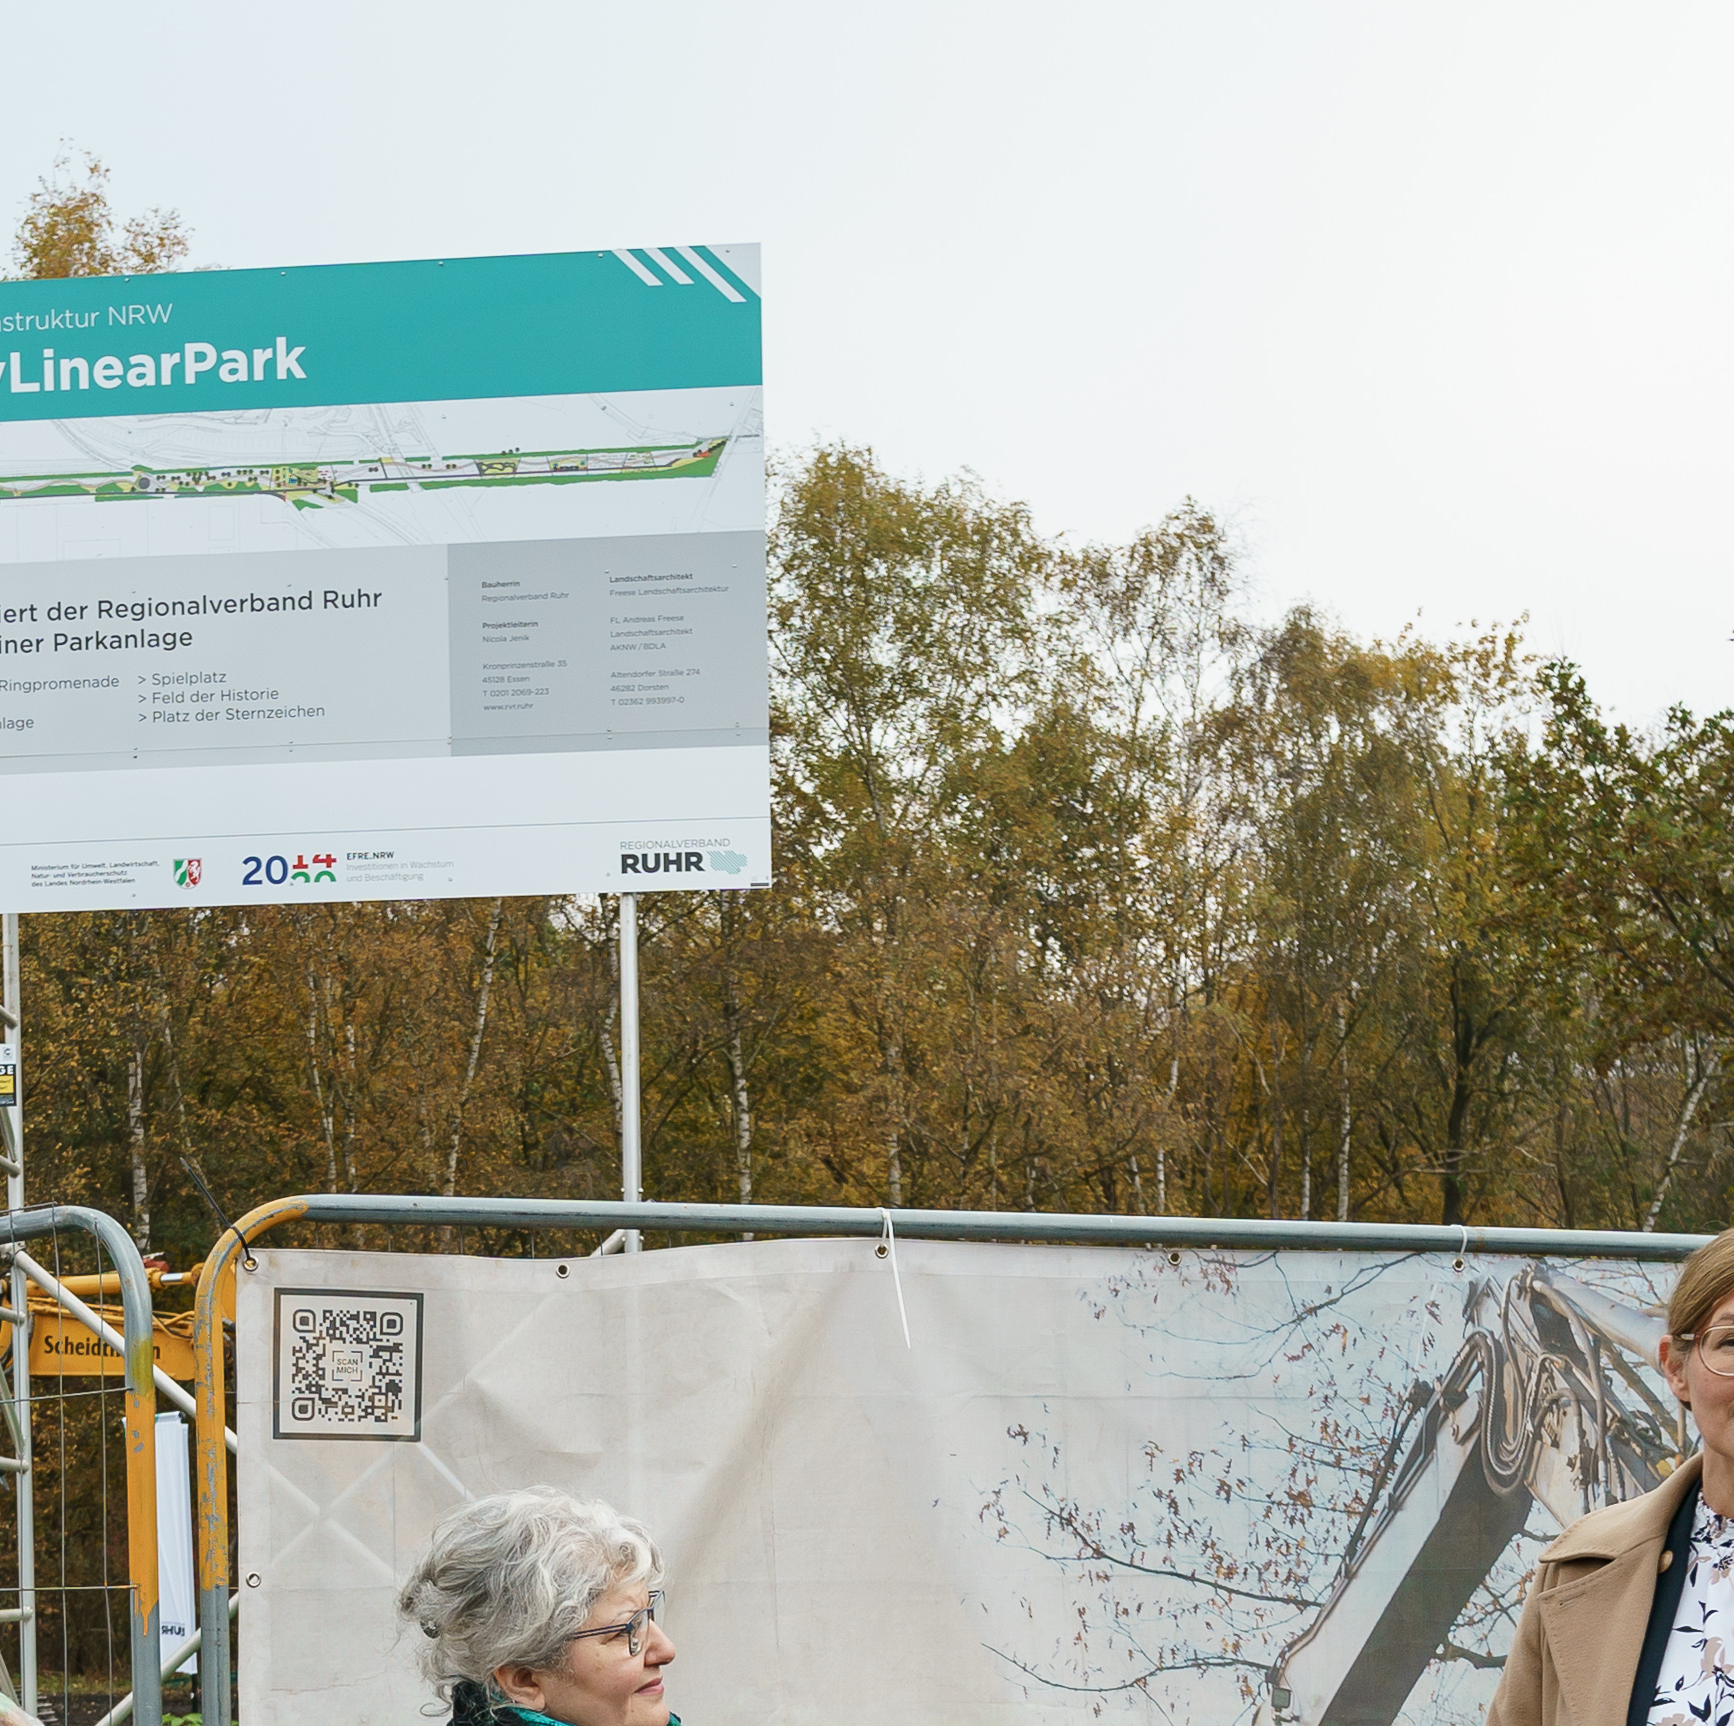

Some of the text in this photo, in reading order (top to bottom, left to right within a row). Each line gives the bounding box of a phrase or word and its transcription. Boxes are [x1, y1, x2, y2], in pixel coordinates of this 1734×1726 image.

[108, 303, 172, 326] NRW
[481, 580, 520, 588] Bauherrin
[609, 573, 693, 583] Landschaftsarchitekt
[481, 591, 570, 603] Regionalverband Ruhr
[609, 585, 729, 597] Freese Landschaftsarchitektur
[47, 603, 88, 622] der
[97, 591, 313, 620] Regionalverband
[323, 588, 382, 610] Ruhr
[482, 621, 538, 630] Projektleiterin
[610, 628, 693, 638] Landschaftsarchitekt
[53, 628, 193, 653] Parkanlage
[482, 660, 555, 671] Kronprinzenstraße
[151, 670, 227, 688] Spielplatz
[507, 675, 530, 683] Essen
[611, 668, 701, 679] Altendorfer Straße 274
[637, 684, 669, 692] Dorsten
[152, 687, 279, 704] Feld der Historie
[483, 702, 534, 711] www.rvr.ruhr
[152, 704, 325, 723] Platz der Sternzeichen
[620, 838, 731, 850] REGIONALVERBAND
[346, 859, 455, 871] Investitionen in Wachstum
[621, 852, 705, 874] RUHR
[67, 870, 127, 878] Verbraucherschutz
[346, 871, 424, 883] und Beschäftigung
[336, 1366, 358, 1374] MICH
